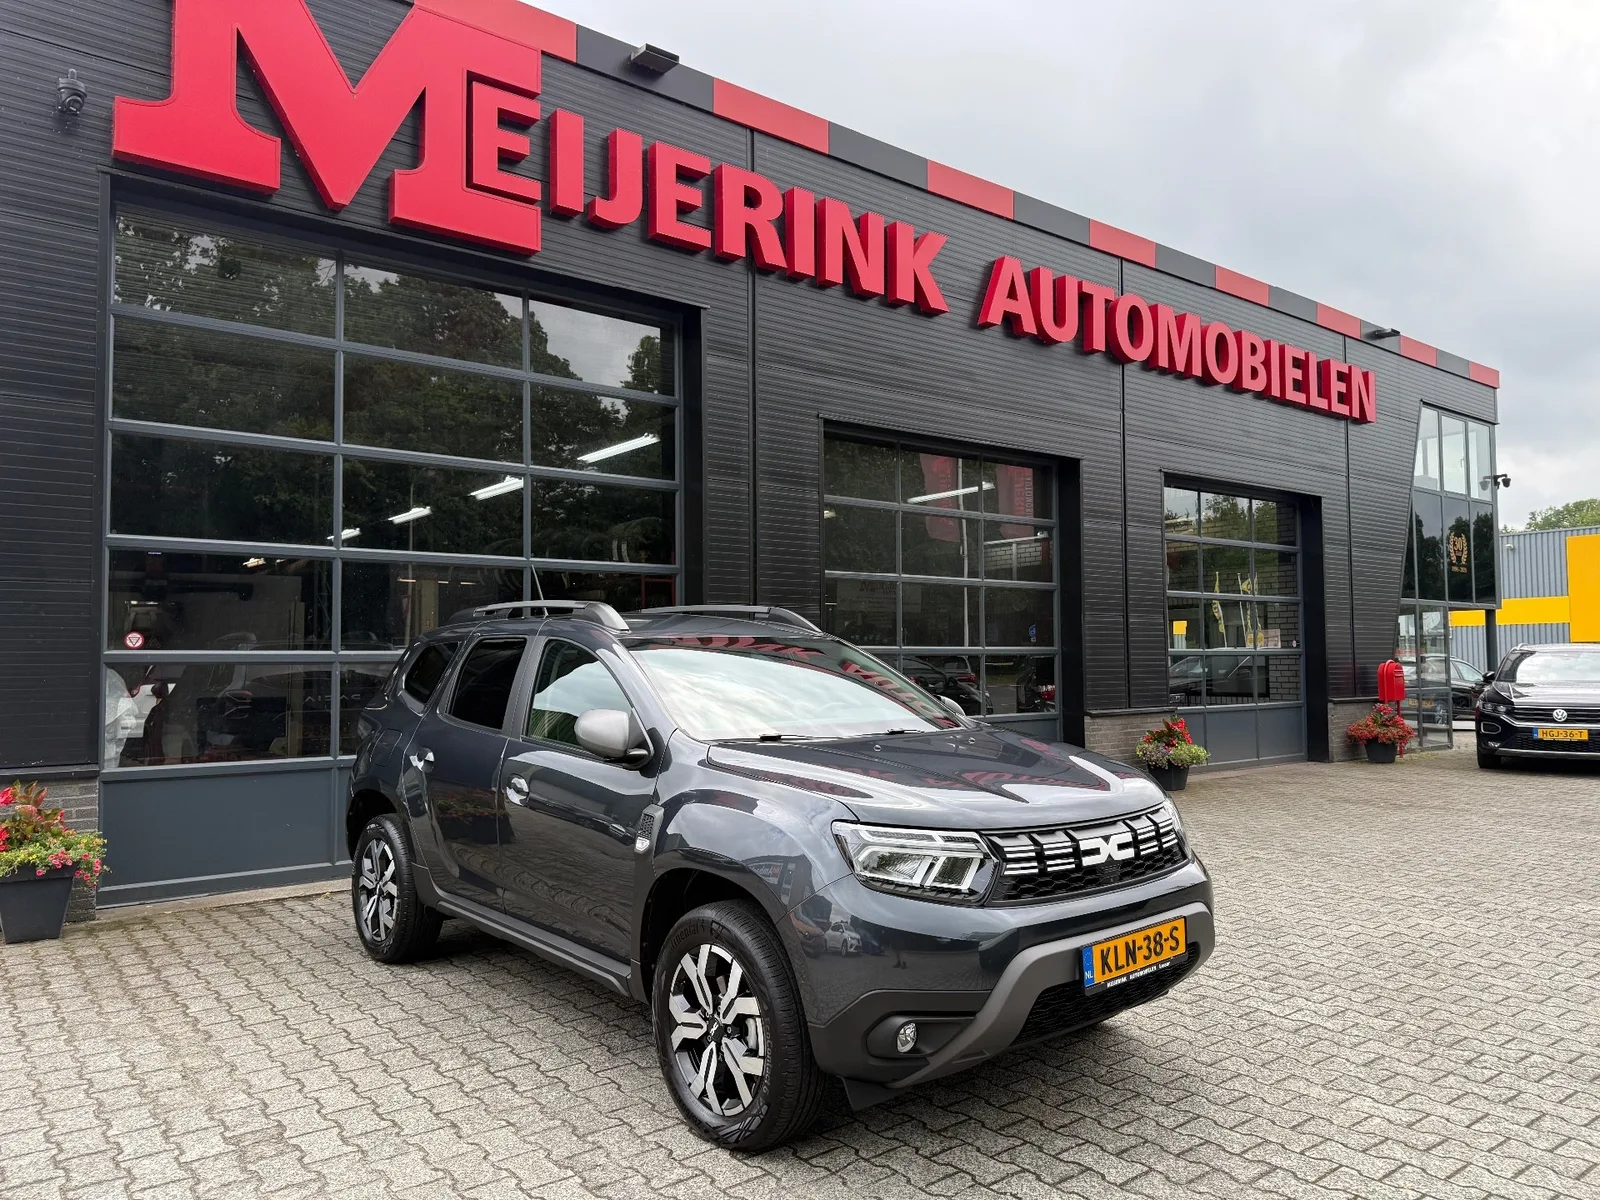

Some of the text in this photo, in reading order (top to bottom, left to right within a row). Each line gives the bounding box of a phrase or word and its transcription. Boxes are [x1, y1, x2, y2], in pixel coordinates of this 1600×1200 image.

[113, 0, 1376, 424] MEIJERINK AUTOMOBIELEN
[1541, 730, 1585, 738] HGJ-36-T
[1100, 926, 1180, 976] KLN-38-S
[1085, 971, 1093, 979] NL
